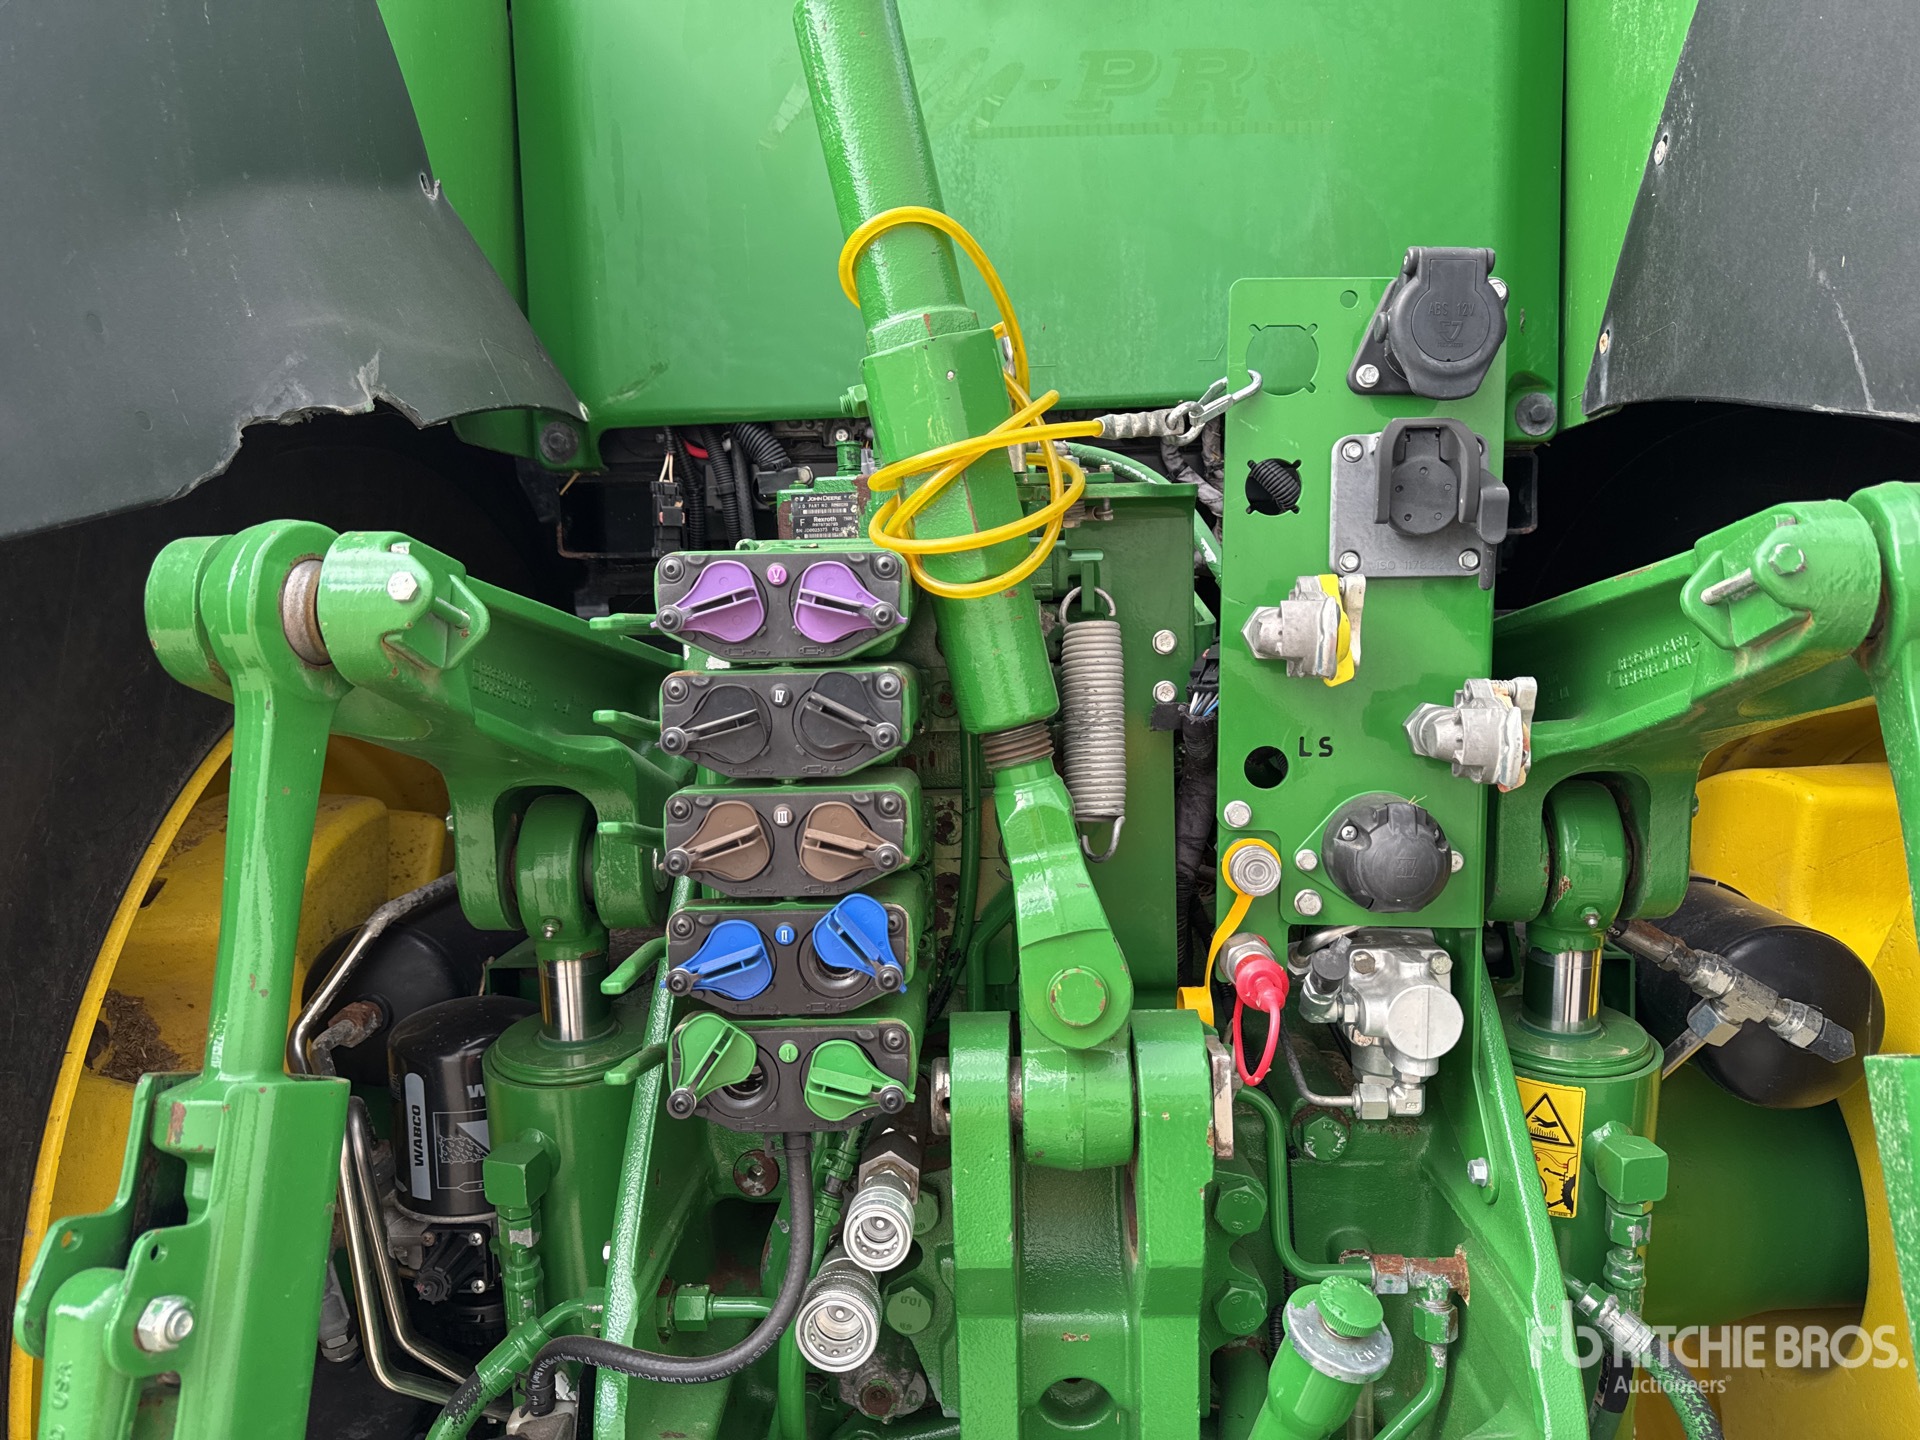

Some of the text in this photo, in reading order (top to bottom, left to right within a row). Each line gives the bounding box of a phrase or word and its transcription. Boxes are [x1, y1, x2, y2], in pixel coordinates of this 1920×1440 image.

[1427, 301, 1476, 317] ABS 12V
[799, 518, 805, 527] F
[772, 569, 781, 582] V
[777, 811, 788, 823] III
[412, 1104, 424, 1167] WABCO
[660, 1376, 682, 1384] Line
[684, 1376, 708, 1384] Fuel
